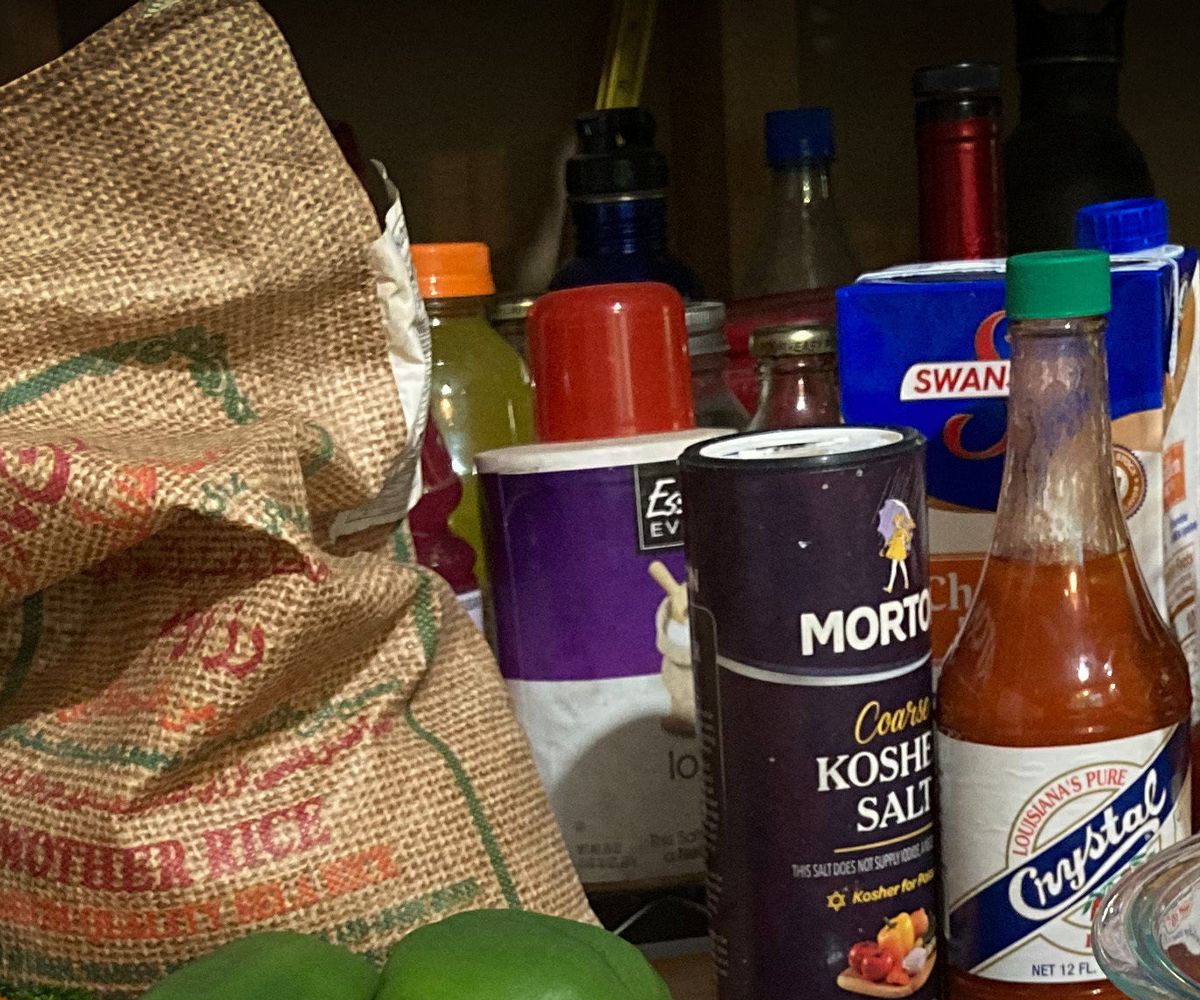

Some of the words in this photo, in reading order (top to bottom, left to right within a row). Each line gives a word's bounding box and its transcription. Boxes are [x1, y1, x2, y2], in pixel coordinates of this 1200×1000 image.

[857, 776, 932, 832] SALT
[1012, 775, 1082, 857] LOUISIANA'S
[1086, 768, 1128, 788] PURE
[203, 796, 332, 878] RICE
[1008, 768, 1167, 921] Crystal
[792, 863, 812, 879] THIS
[813, 861, 833, 878] SALT
[833, 859, 856, 875] DOES
[857, 856, 874, 873] NOT
[875, 852, 900, 870] SUPPLY
[852, 884, 900, 904] Kosher
[901, 878, 917, 893] for
[1032, 964, 1056, 976] NET
[1060, 964, 1074, 975] 12
[1078, 962, 1096, 975] FL.
